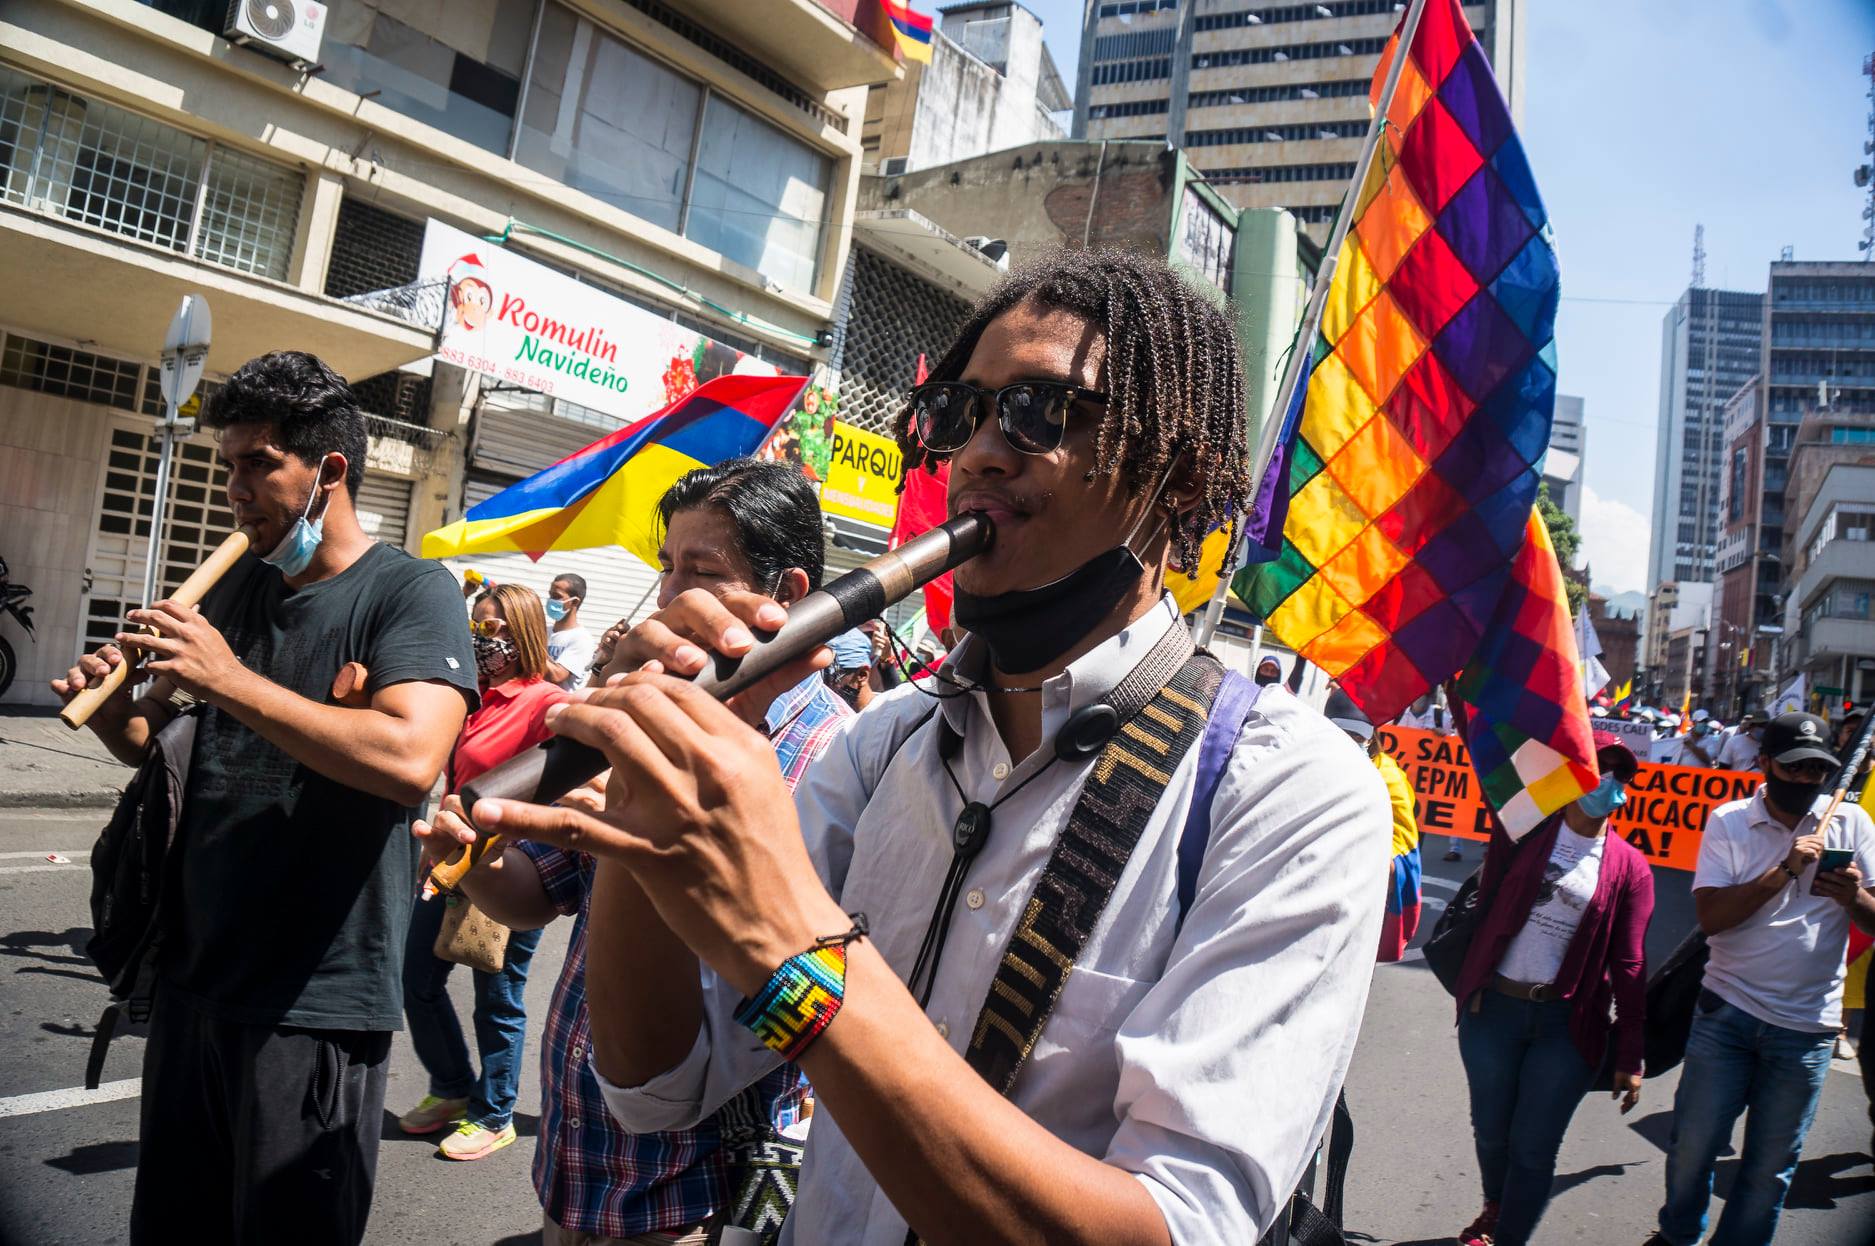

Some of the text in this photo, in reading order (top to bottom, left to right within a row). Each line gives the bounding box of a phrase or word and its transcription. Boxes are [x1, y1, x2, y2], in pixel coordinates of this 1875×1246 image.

[498, 293, 617, 363] Romulin
[468, 355, 496, 374] 6304
[504, 368, 525, 383] 883
[527, 376, 554, 393] 6403
[515, 335, 628, 393] Navideño
[830, 434, 899, 481] PARQU
[1415, 765, 1468, 800] EPM
[1604, 795, 1709, 832] NICACI
